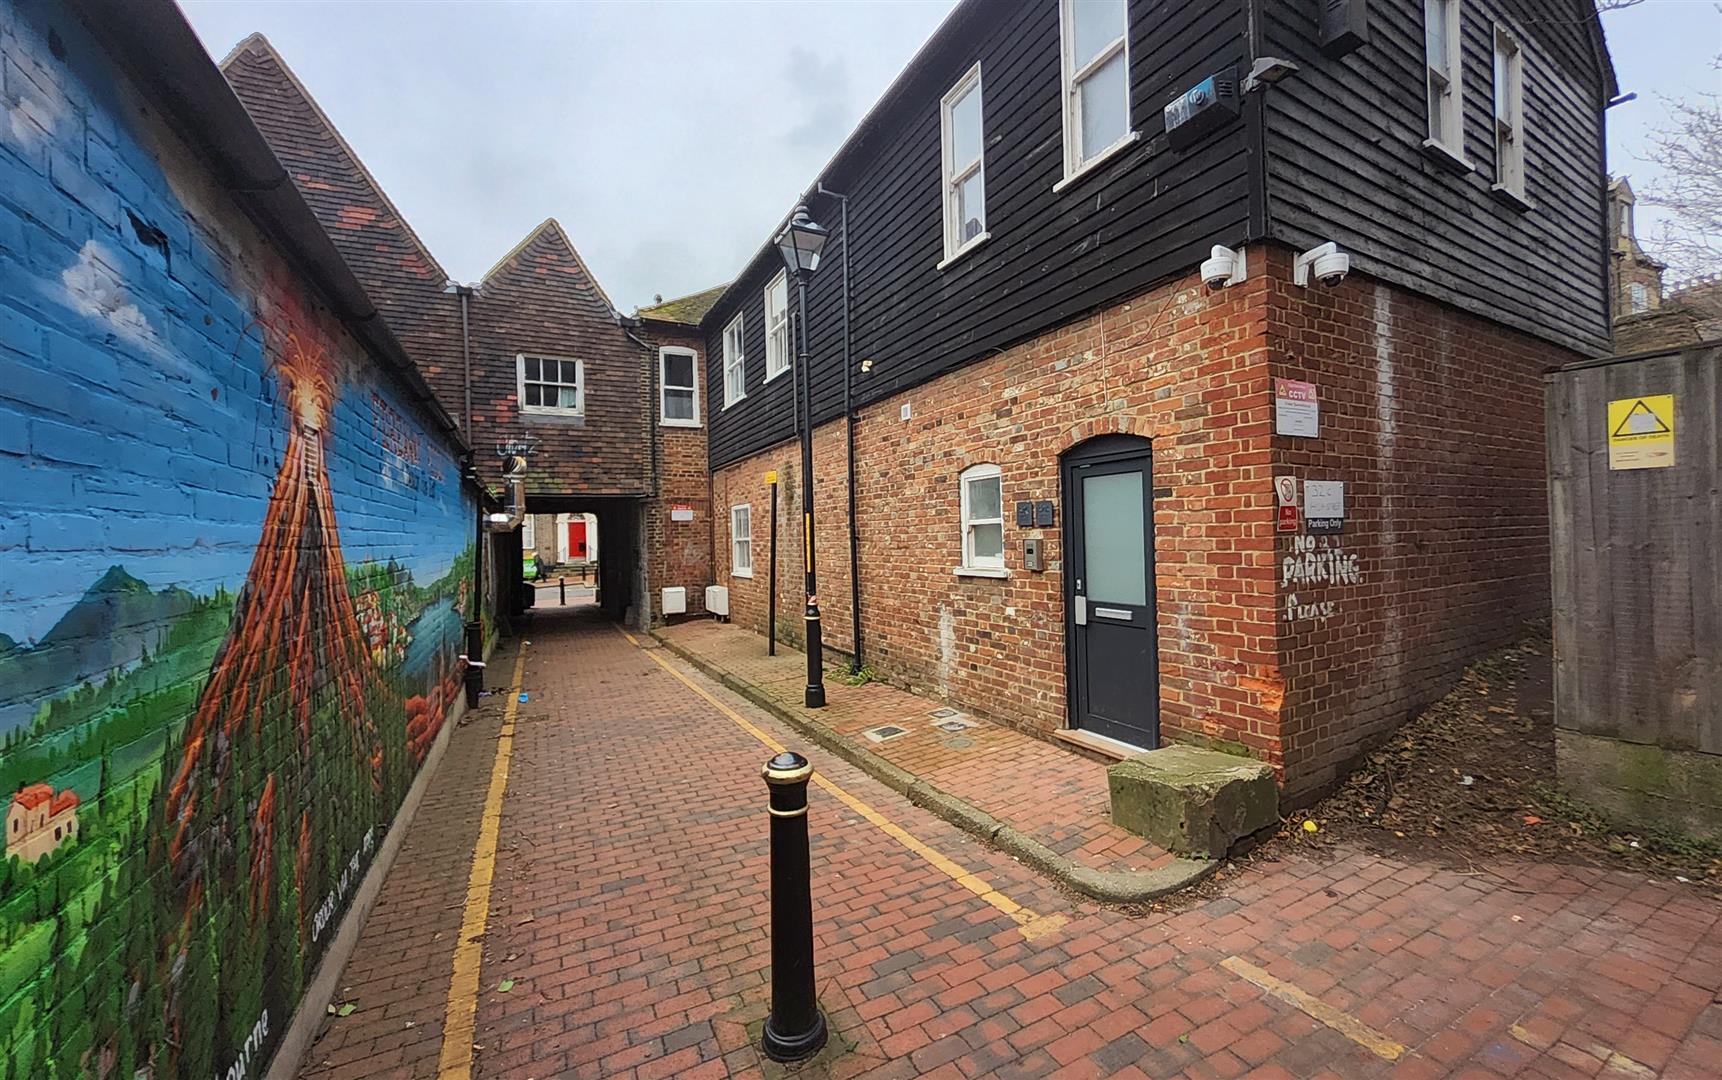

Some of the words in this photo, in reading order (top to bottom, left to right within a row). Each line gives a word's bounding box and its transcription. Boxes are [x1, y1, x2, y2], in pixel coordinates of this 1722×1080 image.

[1288, 390, 1307, 400] CCTV
[1308, 519, 1329, 529] Parking
[1329, 519, 1342, 528] Only
[1294, 535, 1316, 554] NO
[215, 1008, 269, 1080] ourne
